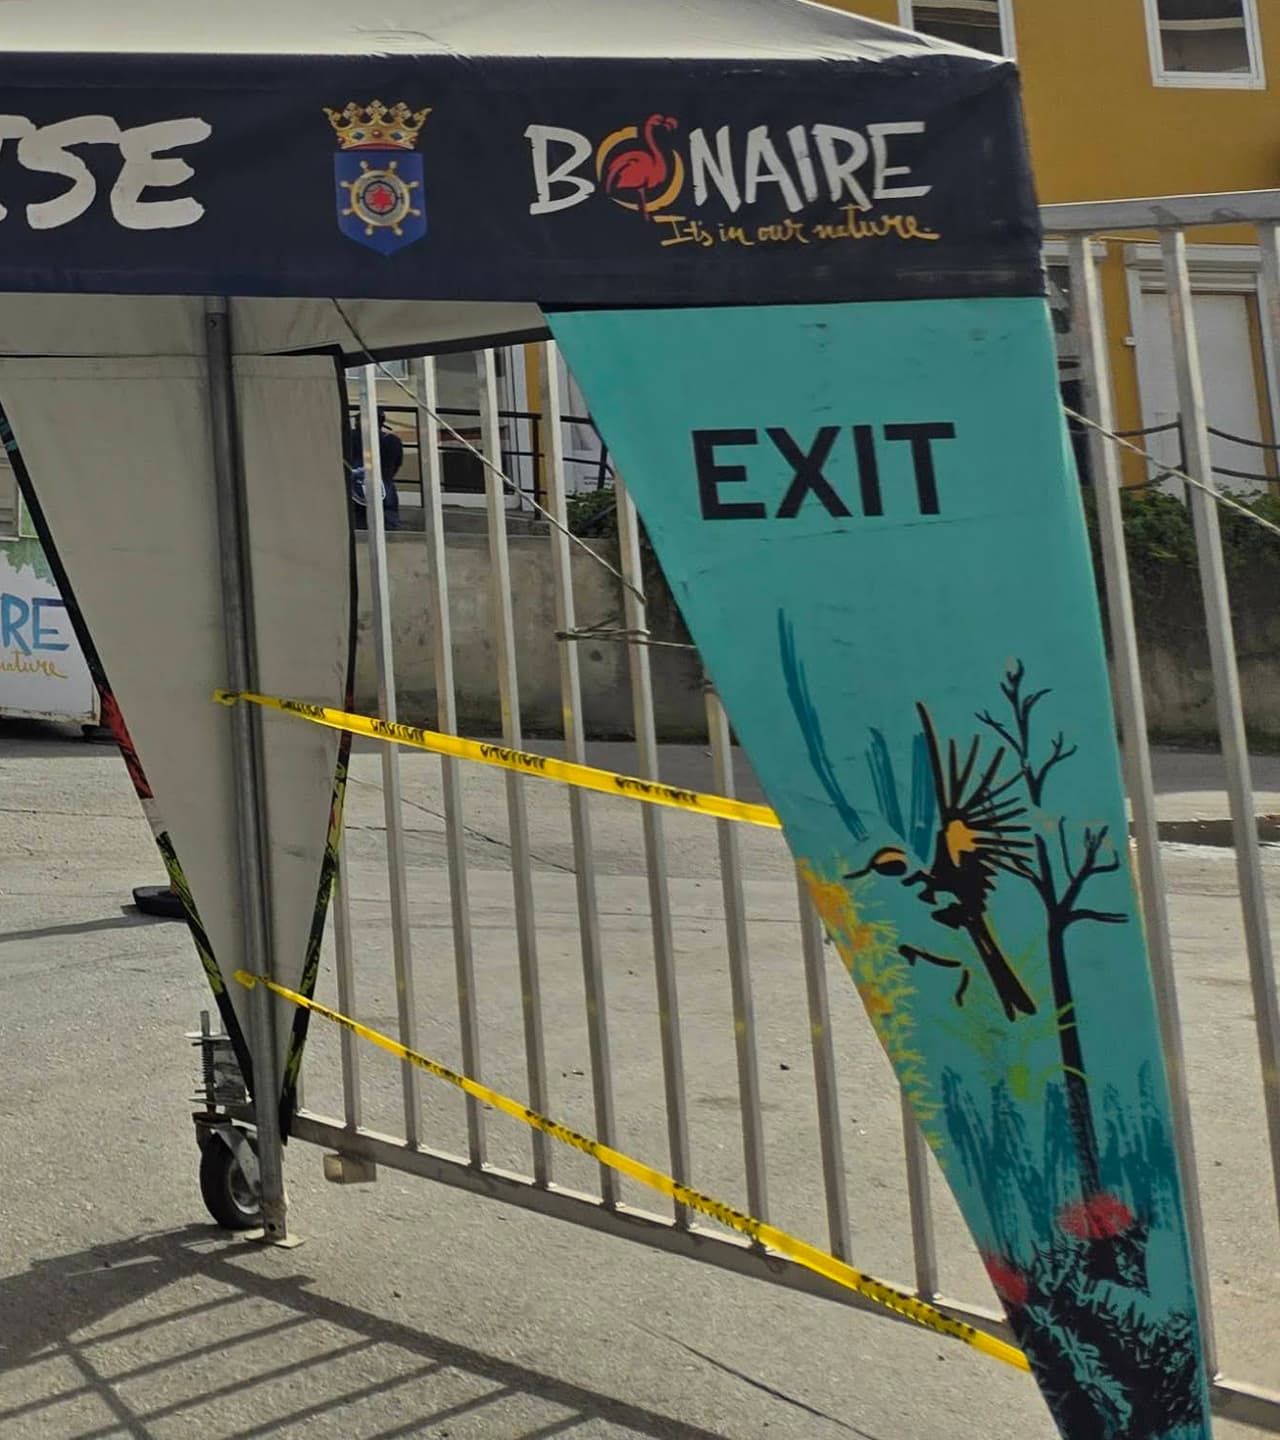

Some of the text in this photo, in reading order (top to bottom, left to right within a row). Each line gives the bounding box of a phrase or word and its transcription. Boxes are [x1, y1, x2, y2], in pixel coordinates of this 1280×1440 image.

[522, 113, 933, 220] BONAIRE
[652, 214, 715, 247] It's
[718, 222, 755, 247] in
[756, 218, 811, 244] our
[689, 421, 957, 522] EXIT
